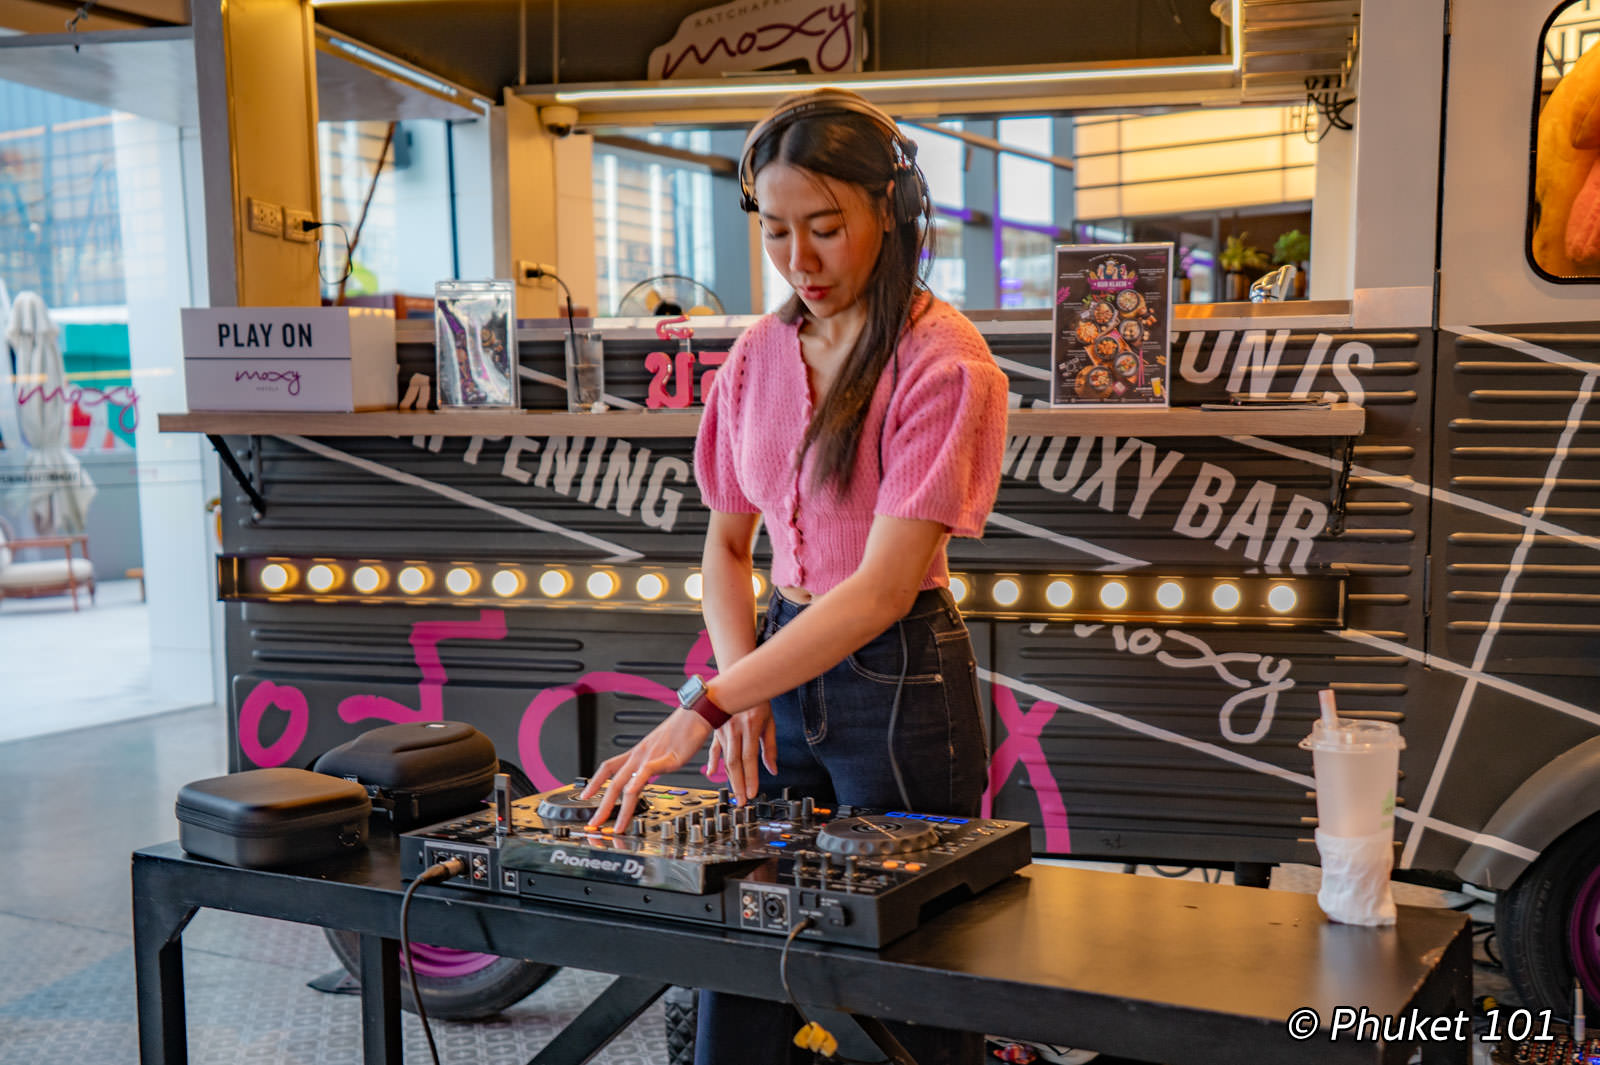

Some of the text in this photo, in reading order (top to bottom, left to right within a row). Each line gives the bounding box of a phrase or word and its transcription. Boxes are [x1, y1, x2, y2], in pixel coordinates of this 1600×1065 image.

[662, 3, 856, 80] moxy
[218, 323, 313, 348] PLAY ON
[235, 370, 302, 396] moxy
[1171, 329, 1291, 400] UN
[18, 385, 140, 434] moxy
[1173, 462, 1329, 567] BAR
[549, 849, 622, 872] Pioneer
